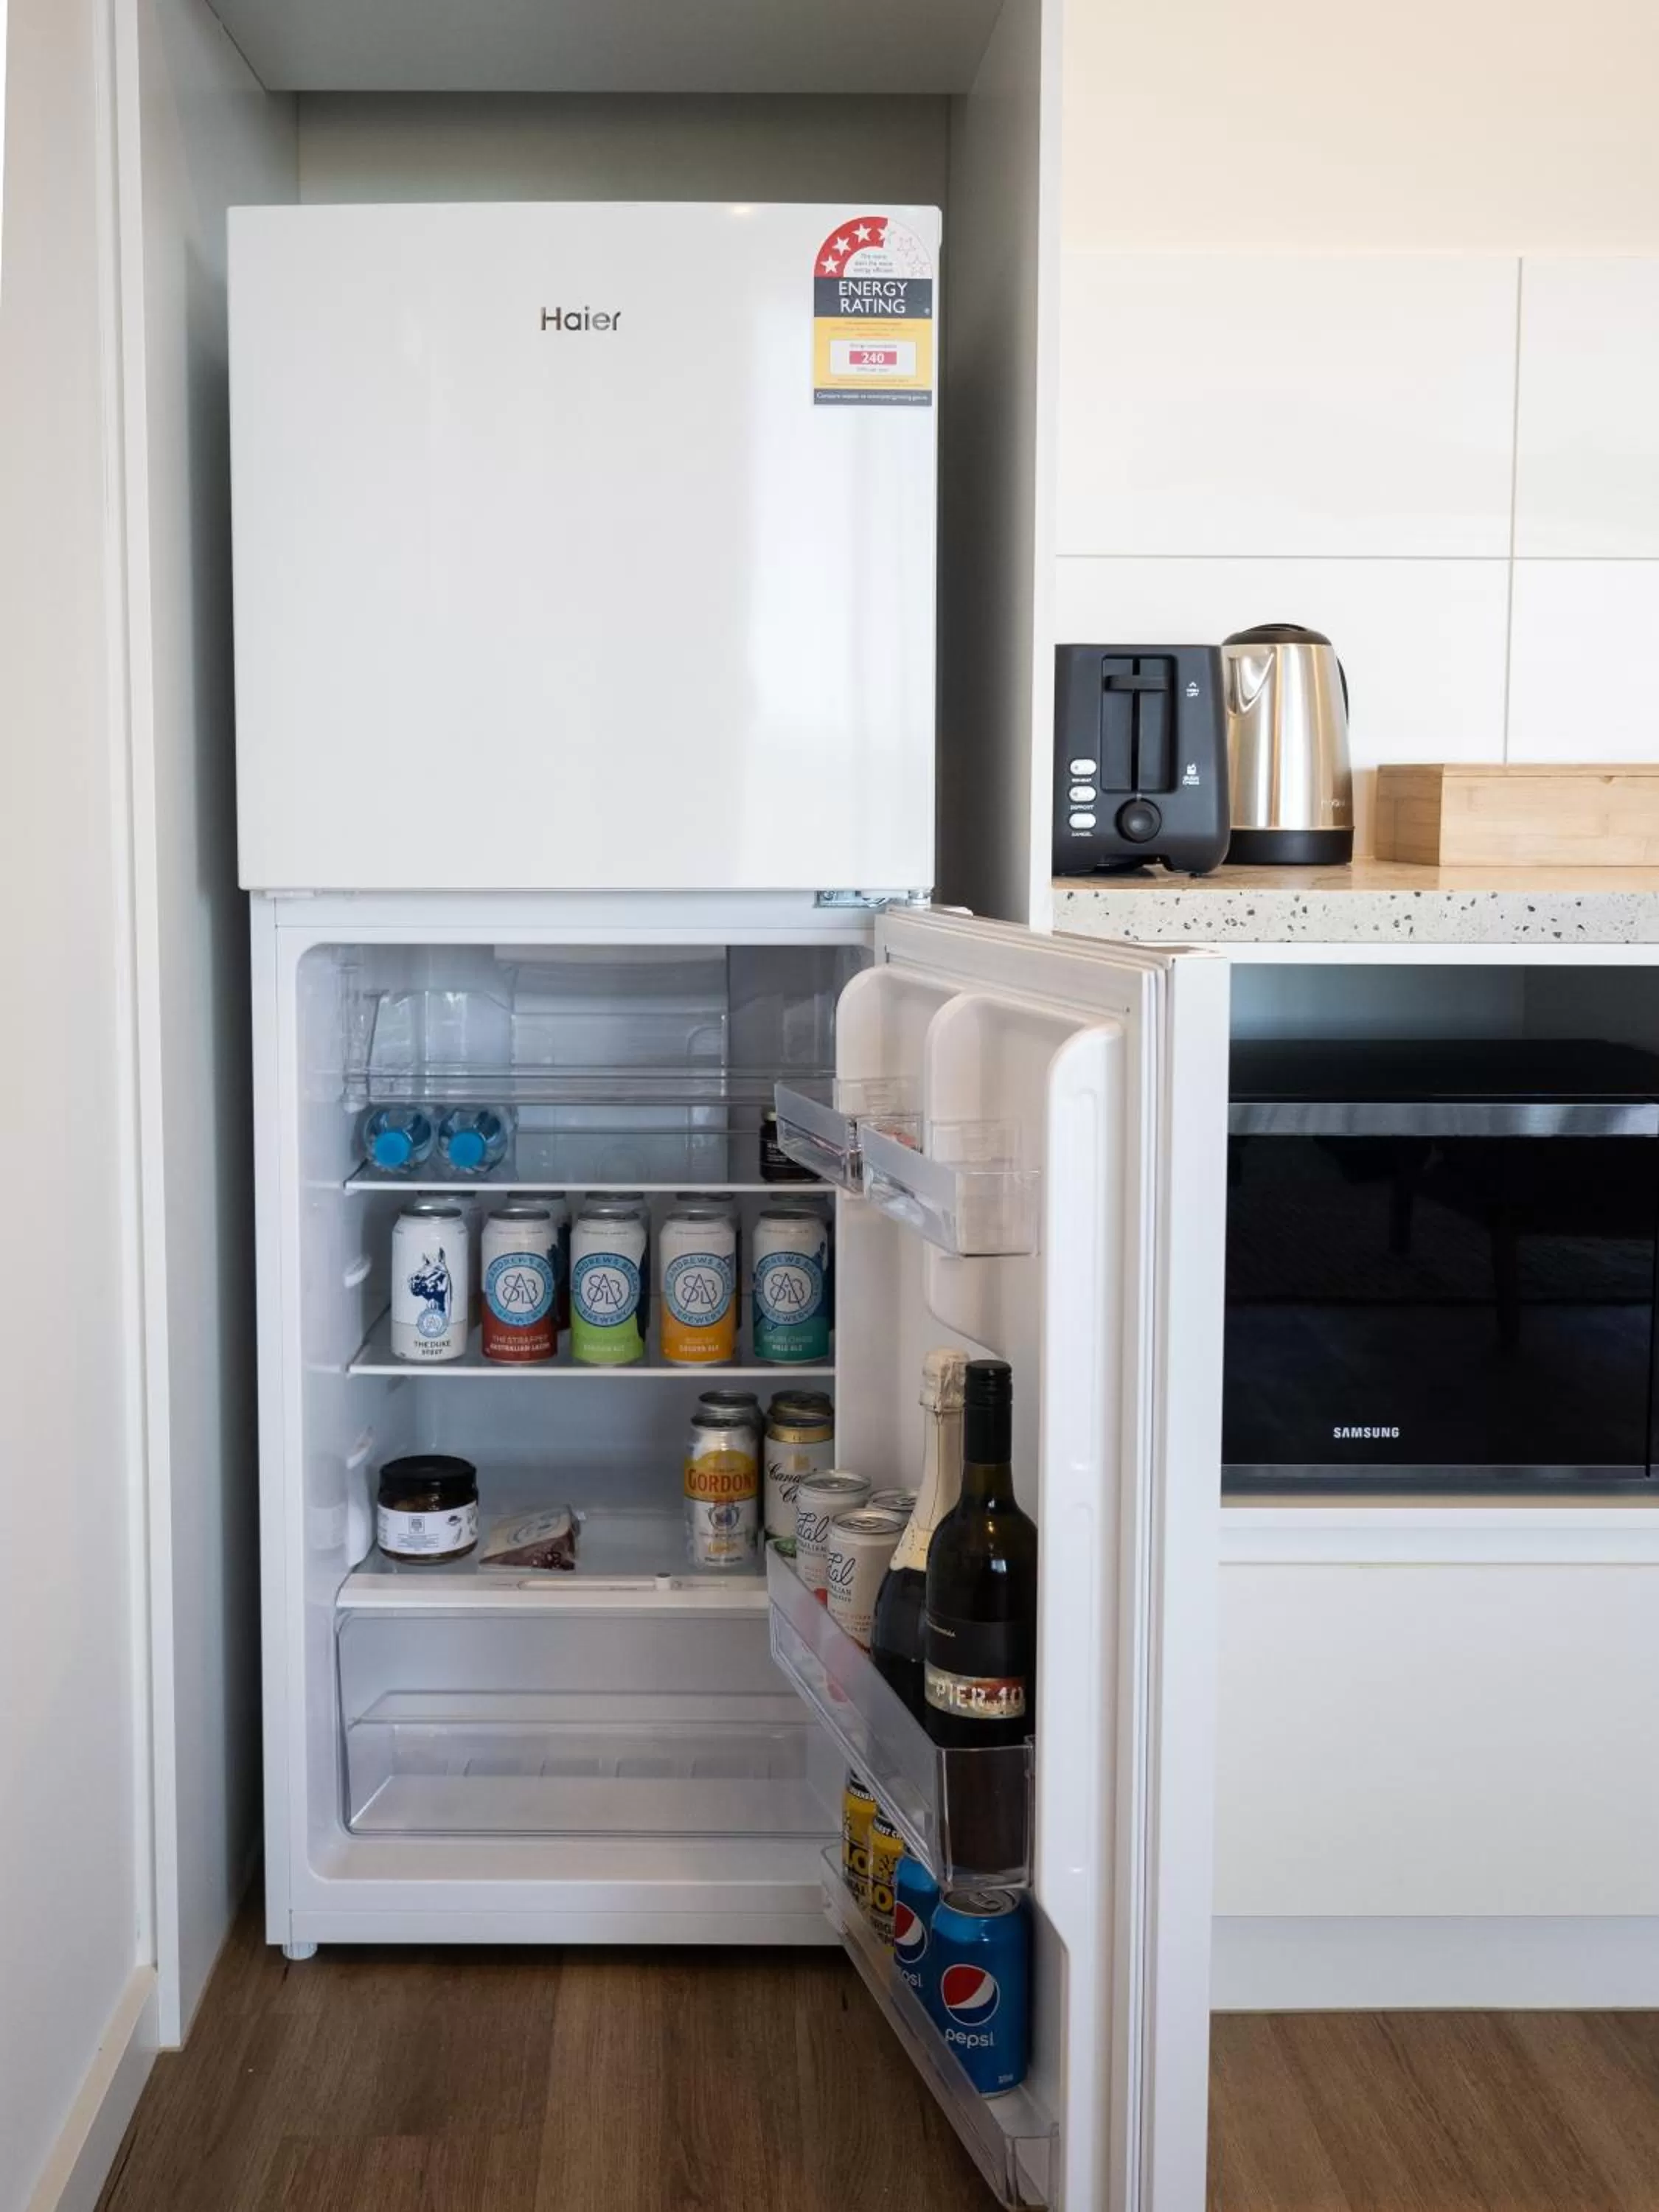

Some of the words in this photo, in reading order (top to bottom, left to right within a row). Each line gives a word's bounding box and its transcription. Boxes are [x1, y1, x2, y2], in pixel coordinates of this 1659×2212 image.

[838, 281, 908, 297] ENERGY
[841, 299, 906, 314] RATING
[541, 306, 622, 331] Haier
[860, 352, 885, 364] 240
[1333, 1427, 1399, 1439] SAMSUNG
[936, 1680, 986, 1708] PIER
[945, 2028, 995, 2049] pepsi
